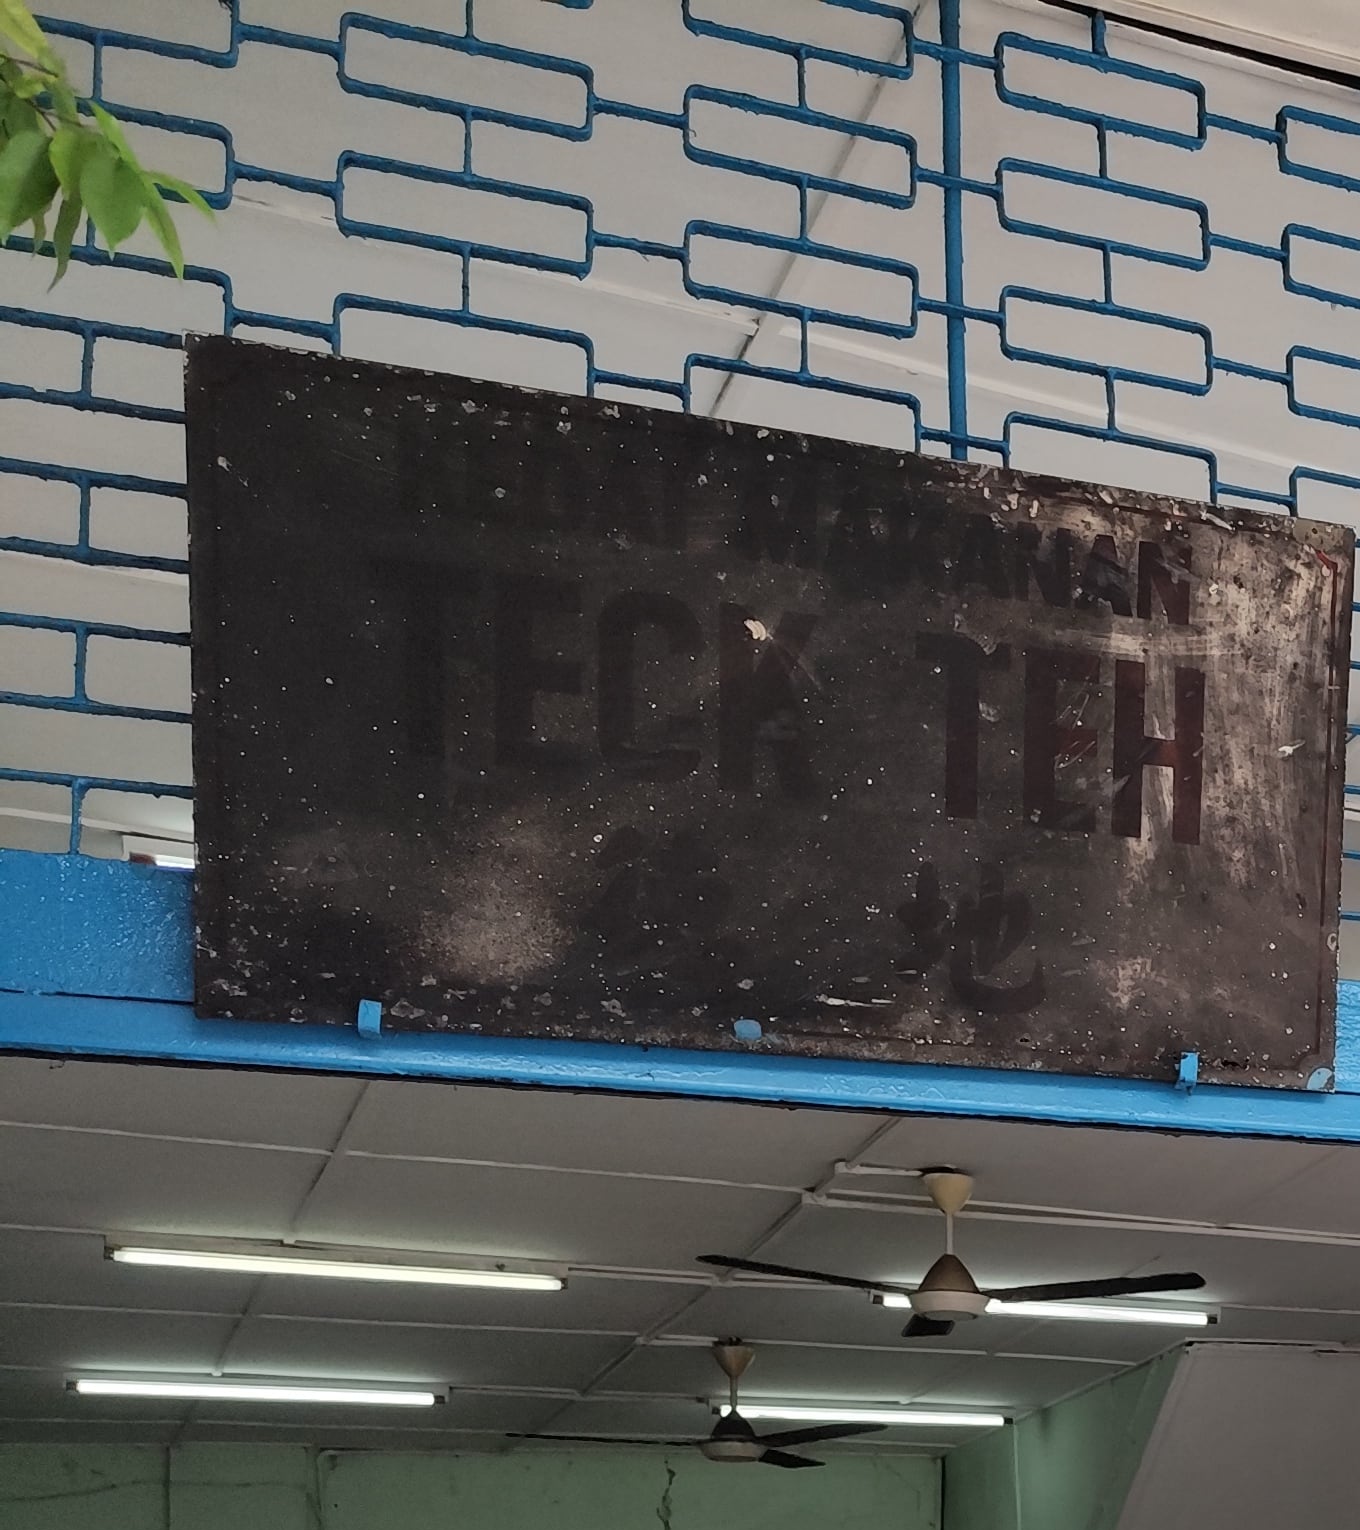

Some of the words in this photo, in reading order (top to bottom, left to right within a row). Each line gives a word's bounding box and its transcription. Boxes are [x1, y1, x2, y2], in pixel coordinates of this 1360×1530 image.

[738, 460, 1194, 625] MAKANAN
[368, 555, 826, 802] TECK
[914, 630, 1208, 846] TEH
